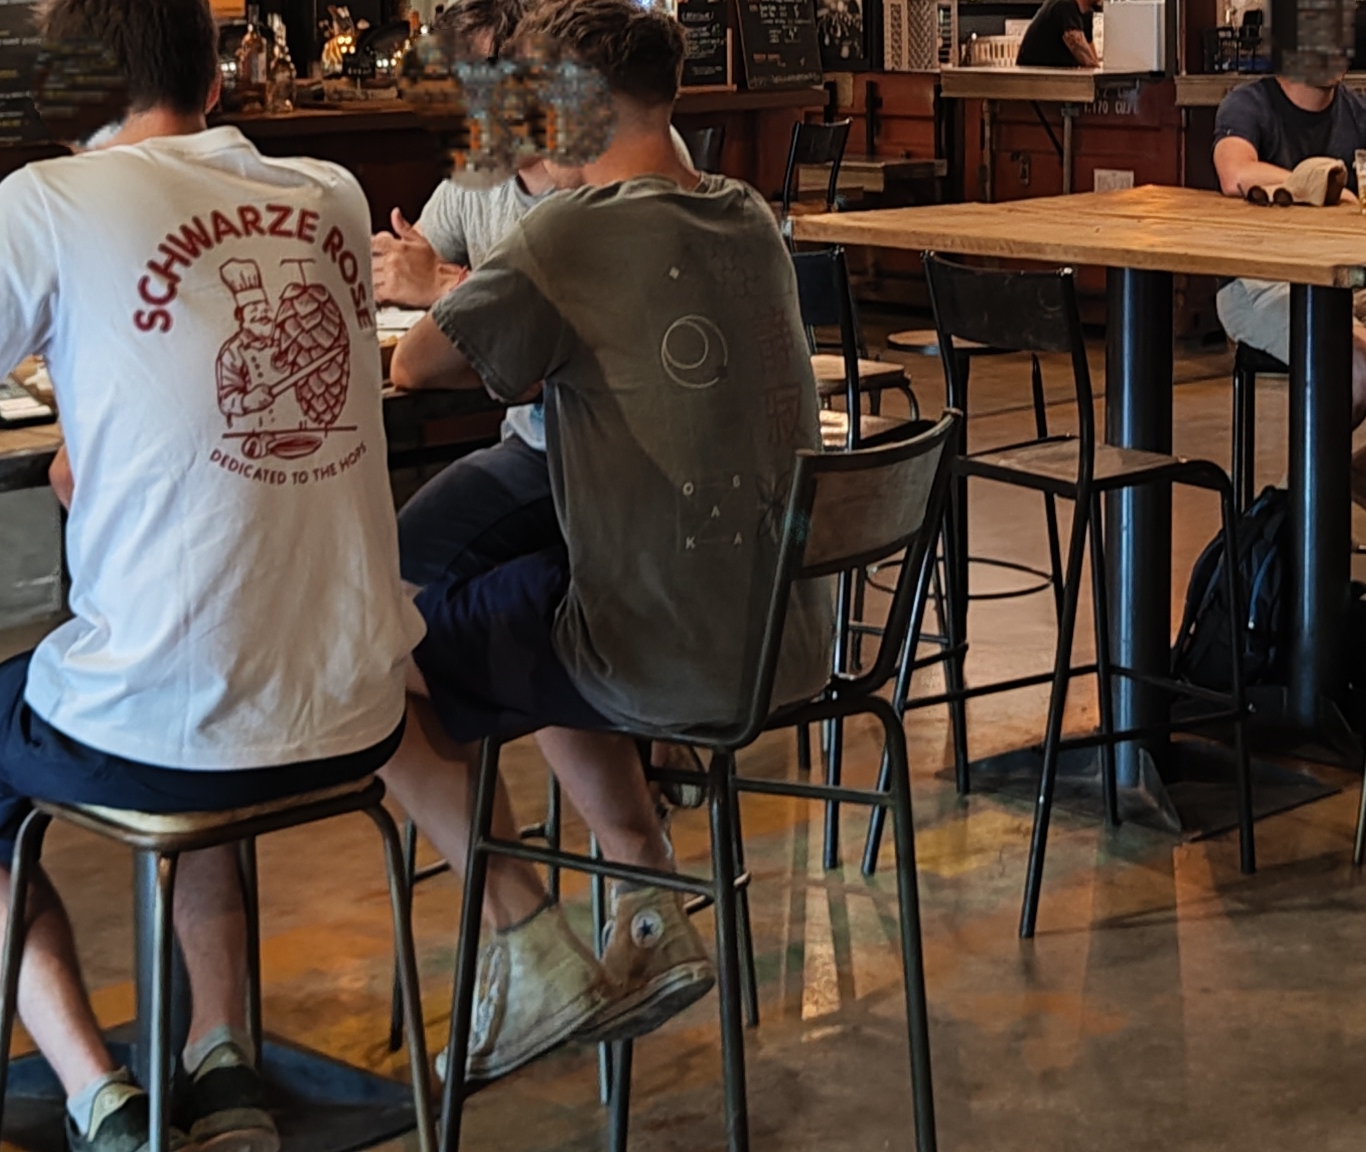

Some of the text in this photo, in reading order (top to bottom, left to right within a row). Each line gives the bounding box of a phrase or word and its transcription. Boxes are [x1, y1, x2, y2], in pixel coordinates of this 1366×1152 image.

[132, 203, 374, 334] SCHWARZE ROSE
[210, 440, 368, 485] DEDICATED TO THE HOPS
